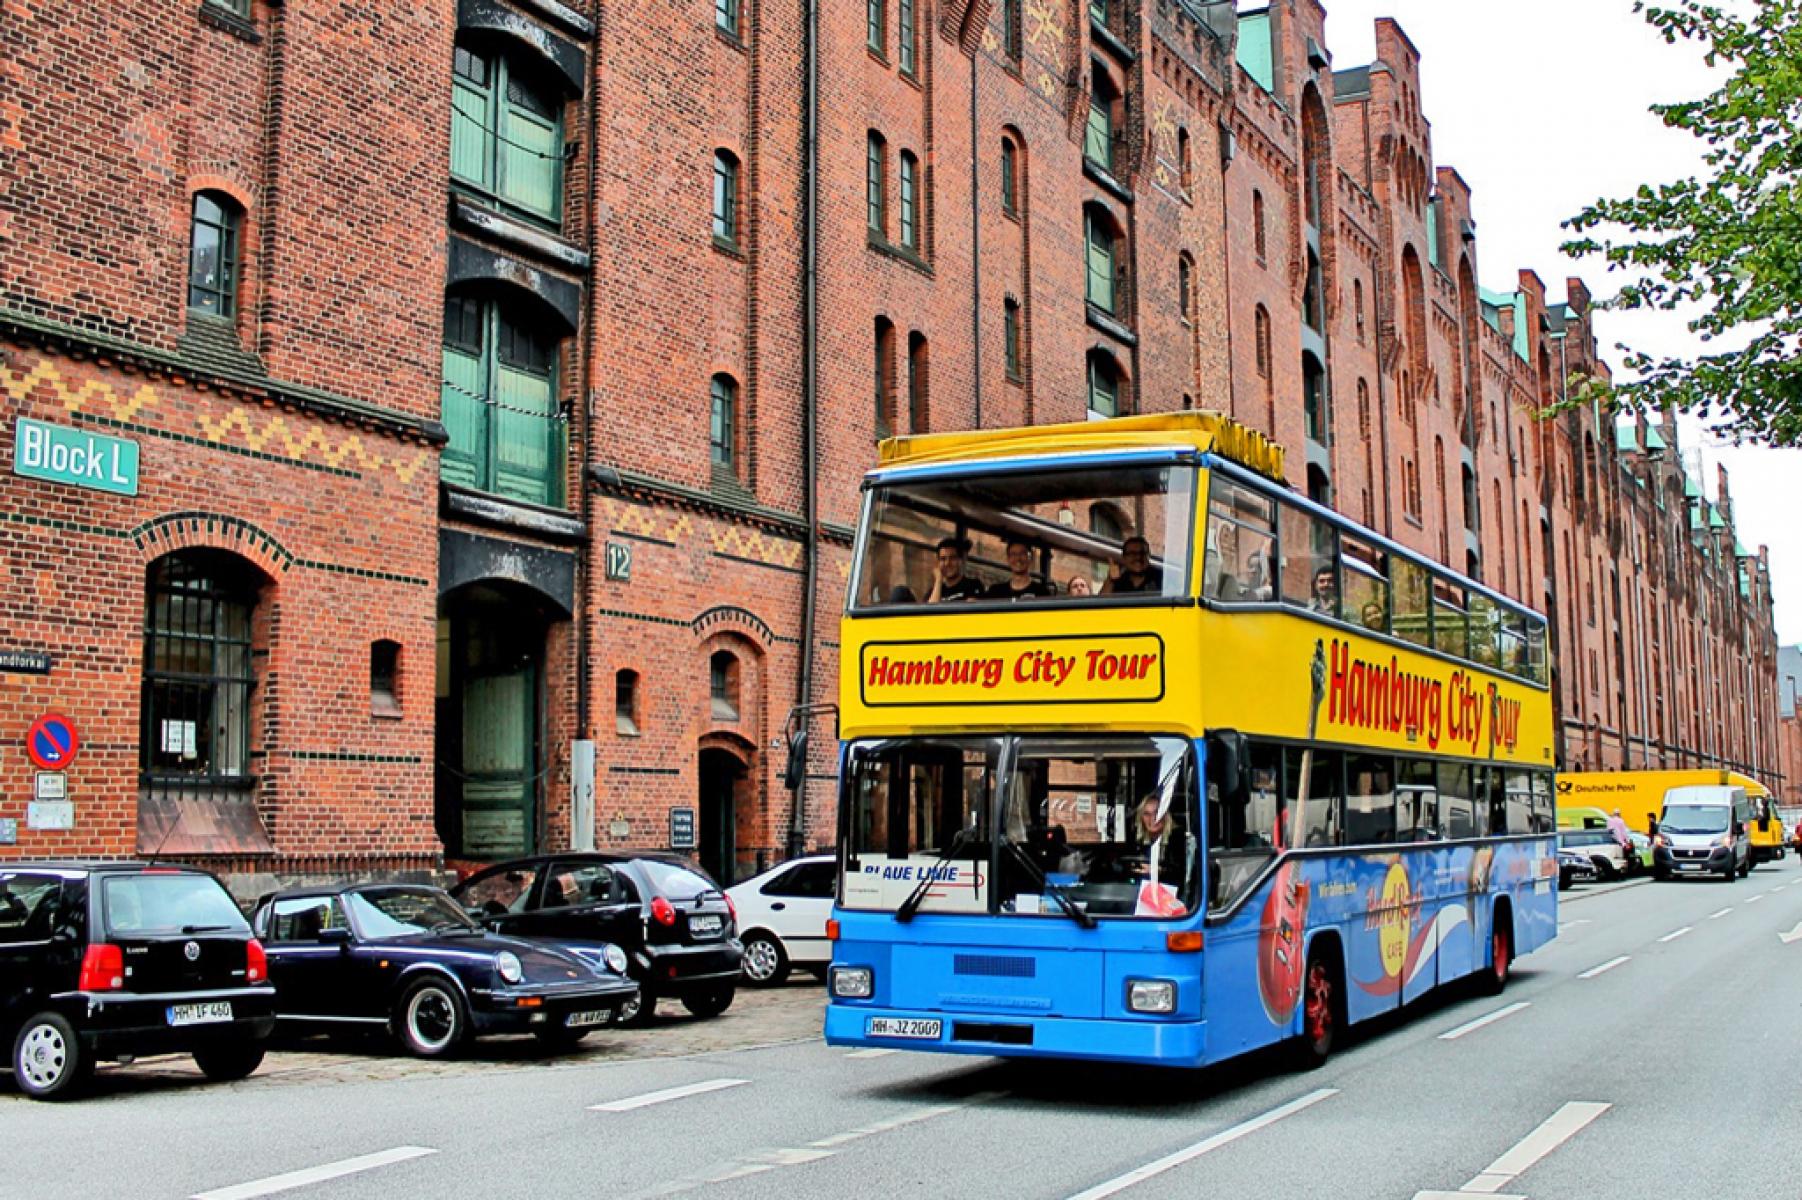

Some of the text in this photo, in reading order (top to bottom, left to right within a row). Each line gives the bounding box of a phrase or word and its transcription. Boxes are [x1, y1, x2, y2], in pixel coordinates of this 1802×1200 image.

[24, 425, 128, 484] Block L
[610, 547, 629, 577] 12
[868, 649, 1157, 688] Hamburg City Tour
[1328, 638, 1442, 750] Hamburg
[1447, 669, 1484, 755] City
[1575, 784, 1636, 792] Deutsche Post
[911, 1021, 939, 1036] 2009
